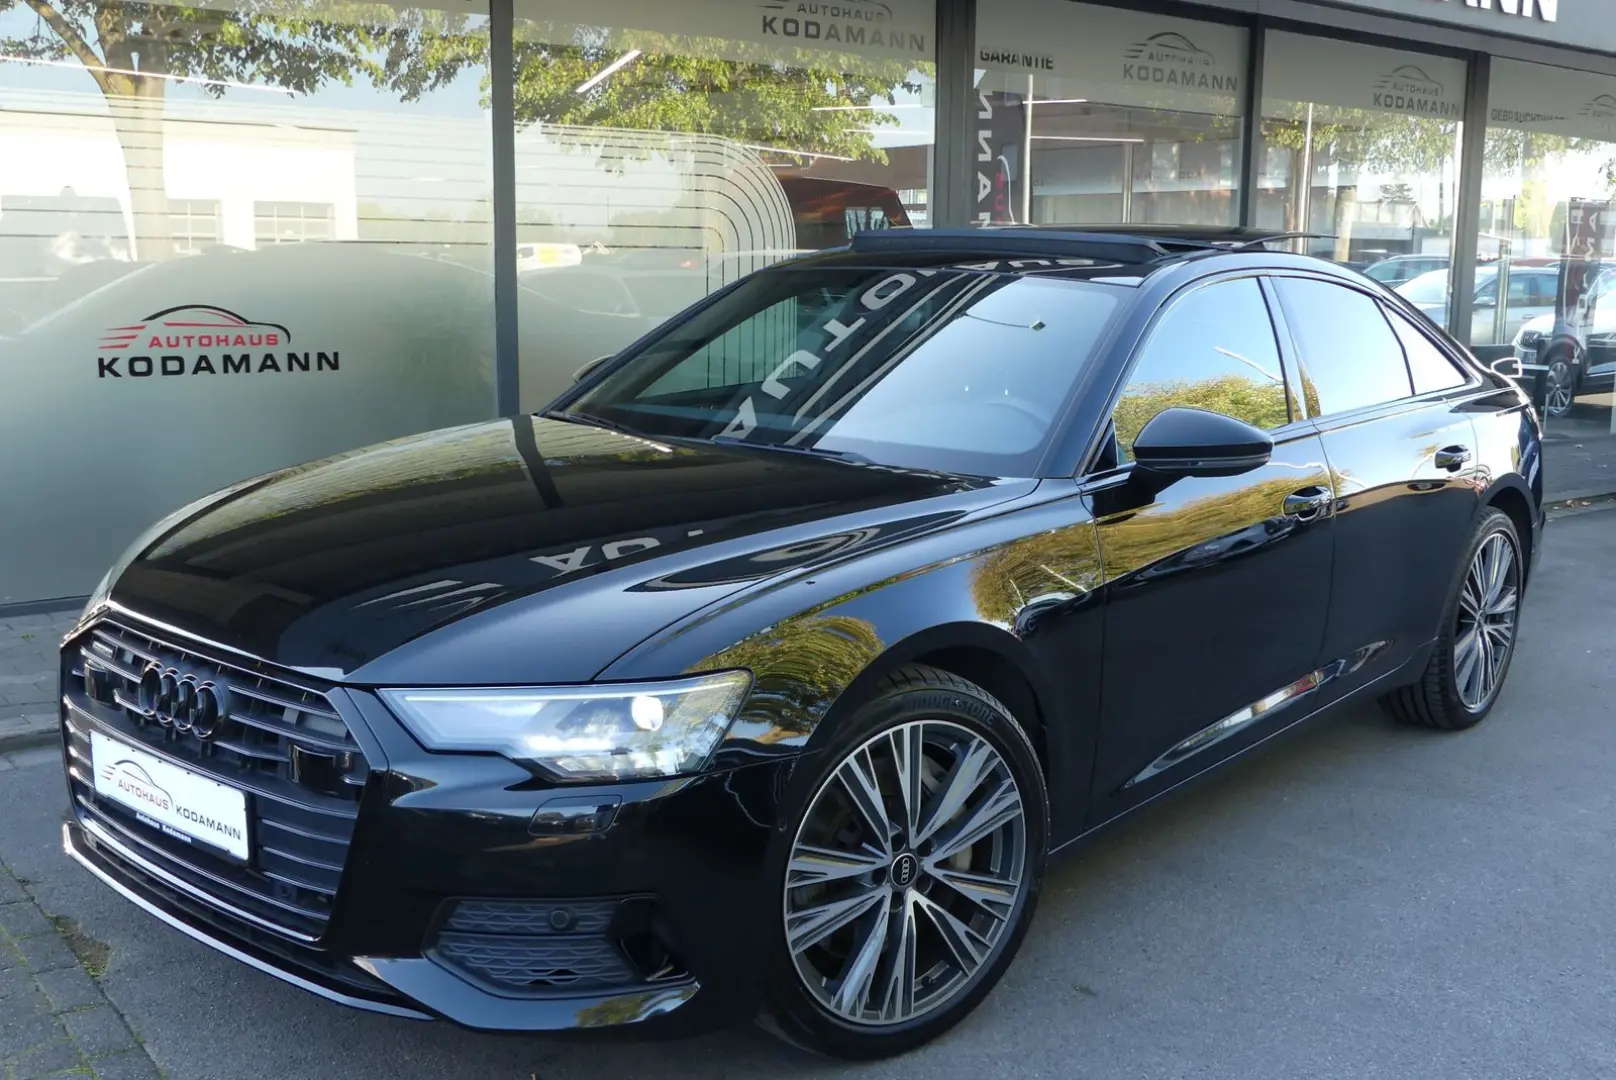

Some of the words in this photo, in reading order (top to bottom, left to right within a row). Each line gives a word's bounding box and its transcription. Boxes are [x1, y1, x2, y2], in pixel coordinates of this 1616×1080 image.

[797, 3, 884, 22] AUTOHAUS
[762, 15, 925, 52] KODAMANN
[980, 47, 1054, 70] GARANTIE
[1123, 63, 1238, 91] KODAMANN
[1392, 82, 1439, 96] AUTOHAUS
[1373, 93, 1460, 116] KODAMANN
[148, 332, 279, 349] AUTOHAUS
[97, 351, 340, 379] KODAMANN
[117, 779, 169, 810] AUTOHAUS
[175, 804, 242, 841] KODAMANN
